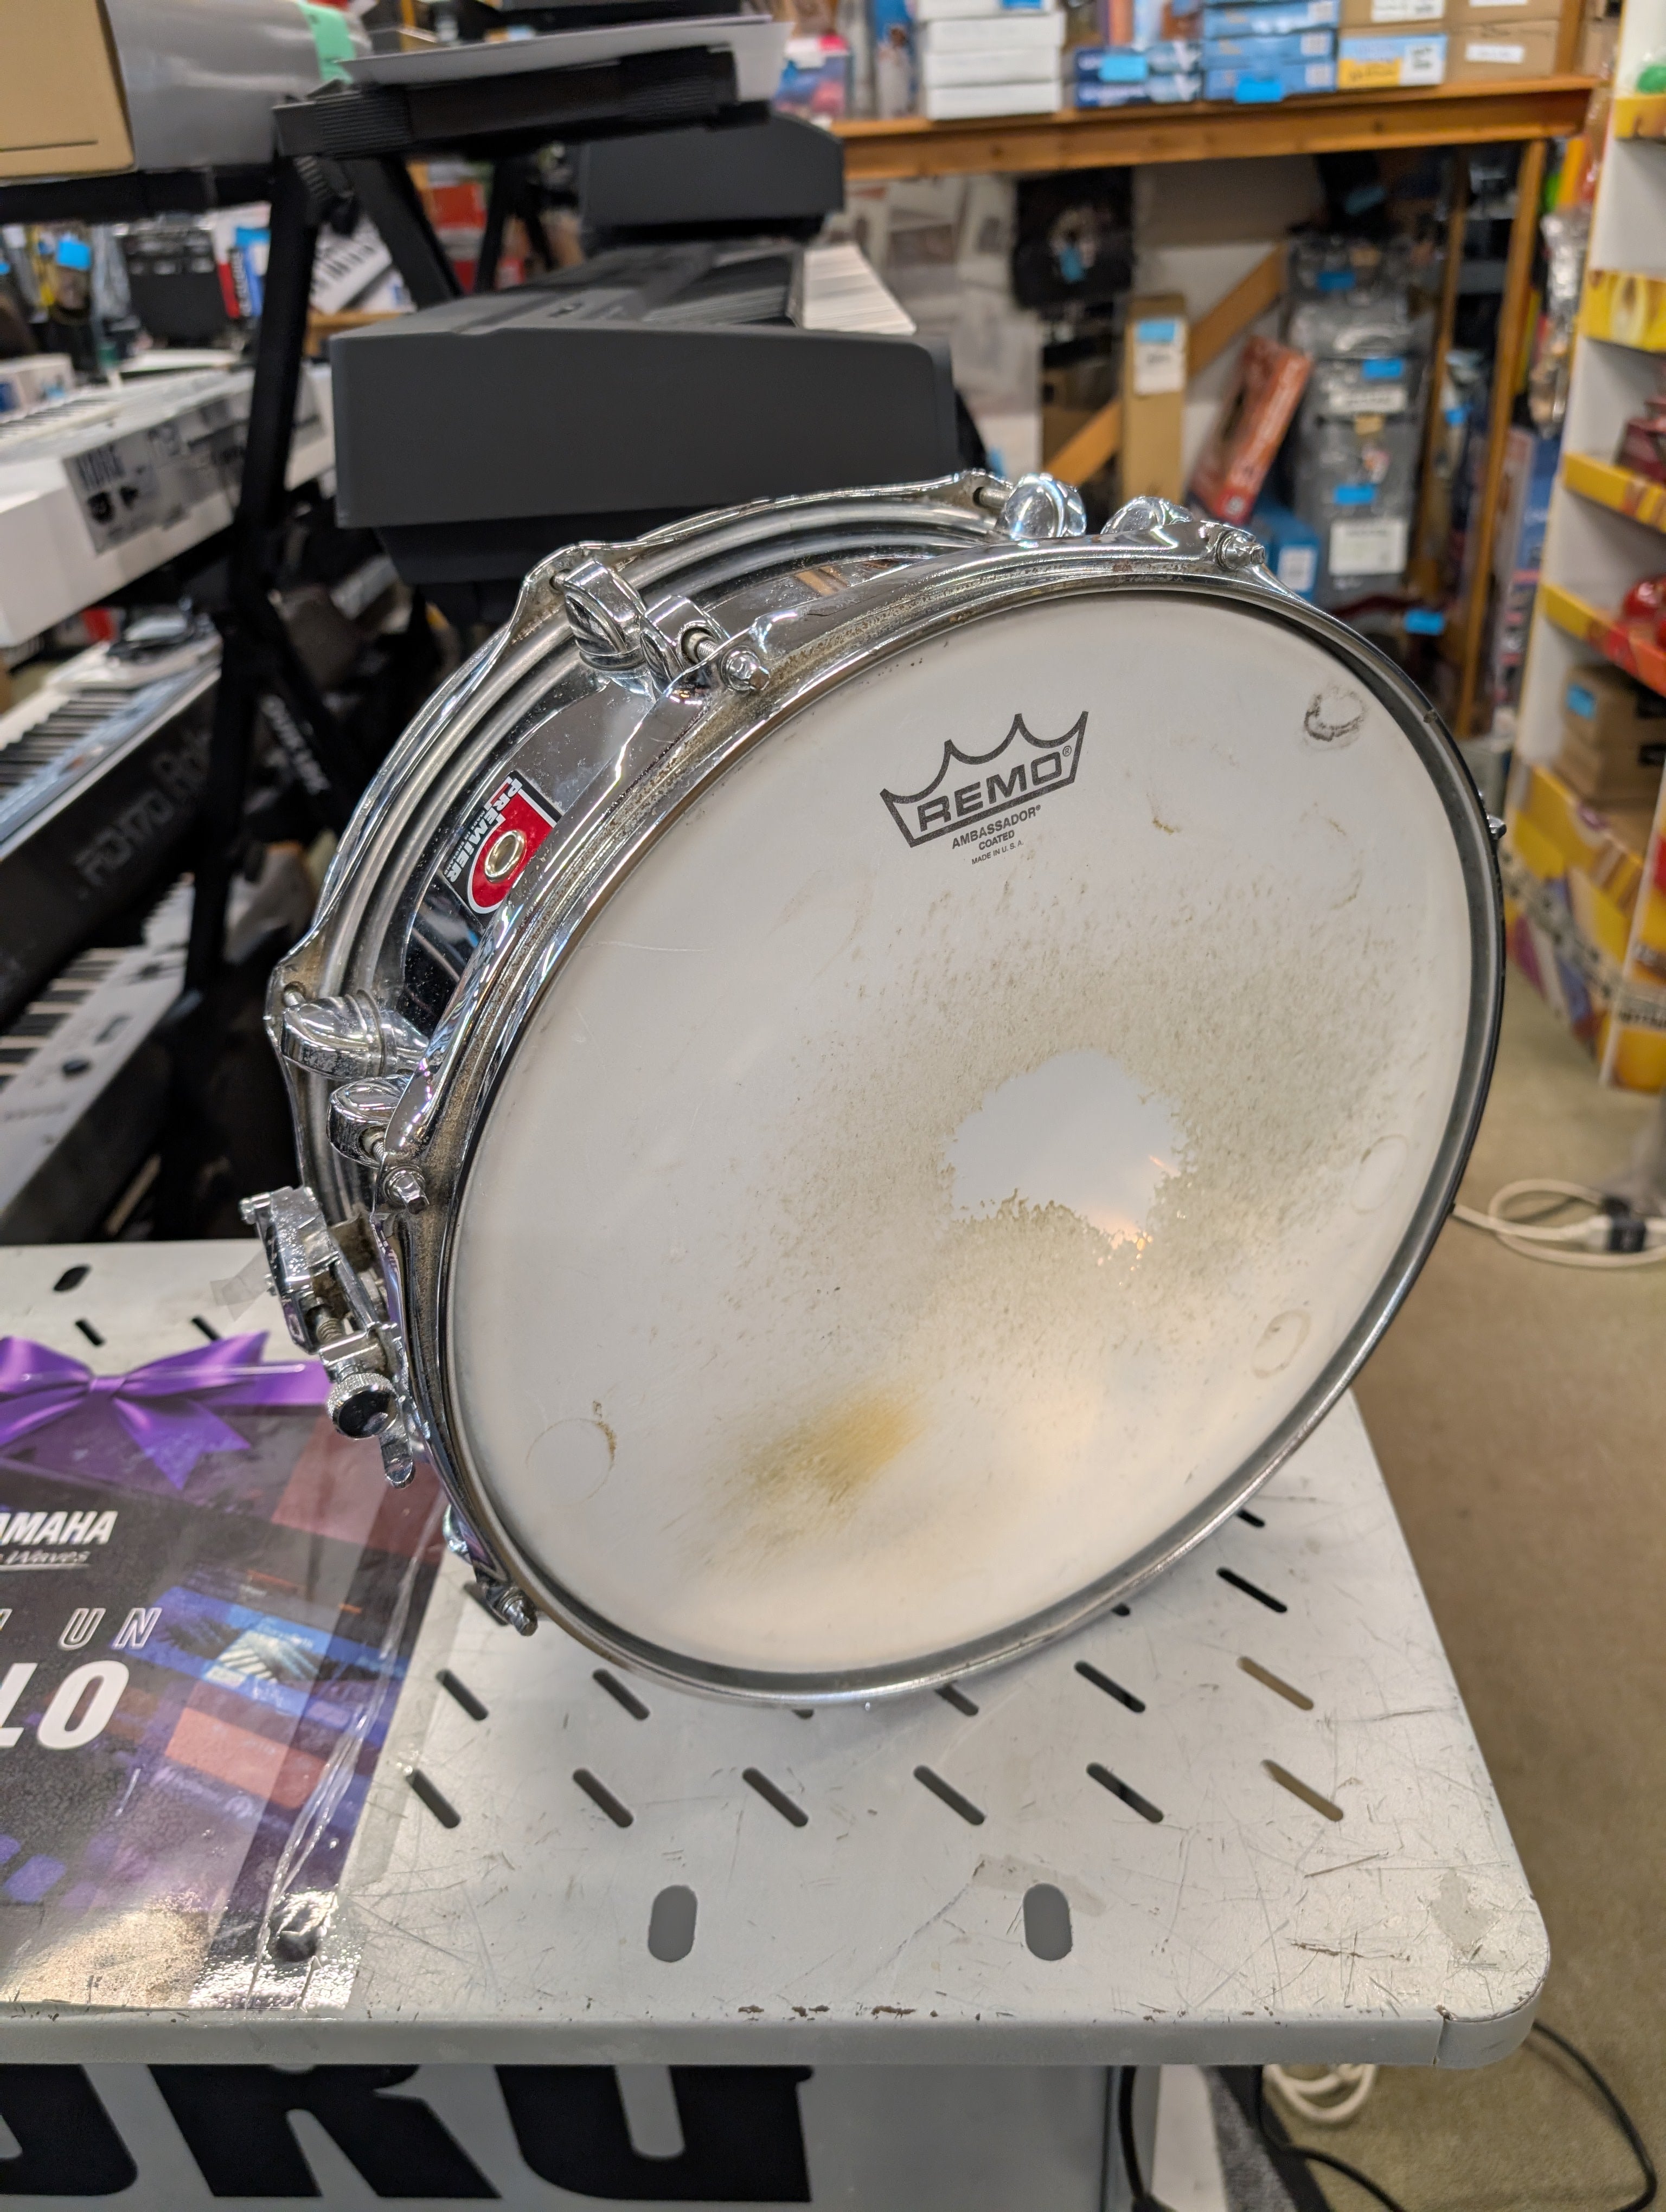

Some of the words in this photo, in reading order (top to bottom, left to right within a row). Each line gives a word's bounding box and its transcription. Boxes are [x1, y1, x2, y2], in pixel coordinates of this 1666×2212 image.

[464, 831, 471, 840] IN
[978, 829, 1015, 851] COATED
[444, 841, 465, 875] ENGLAND
[971, 852, 991, 865] MADE
[993, 848, 1001, 857] IN
